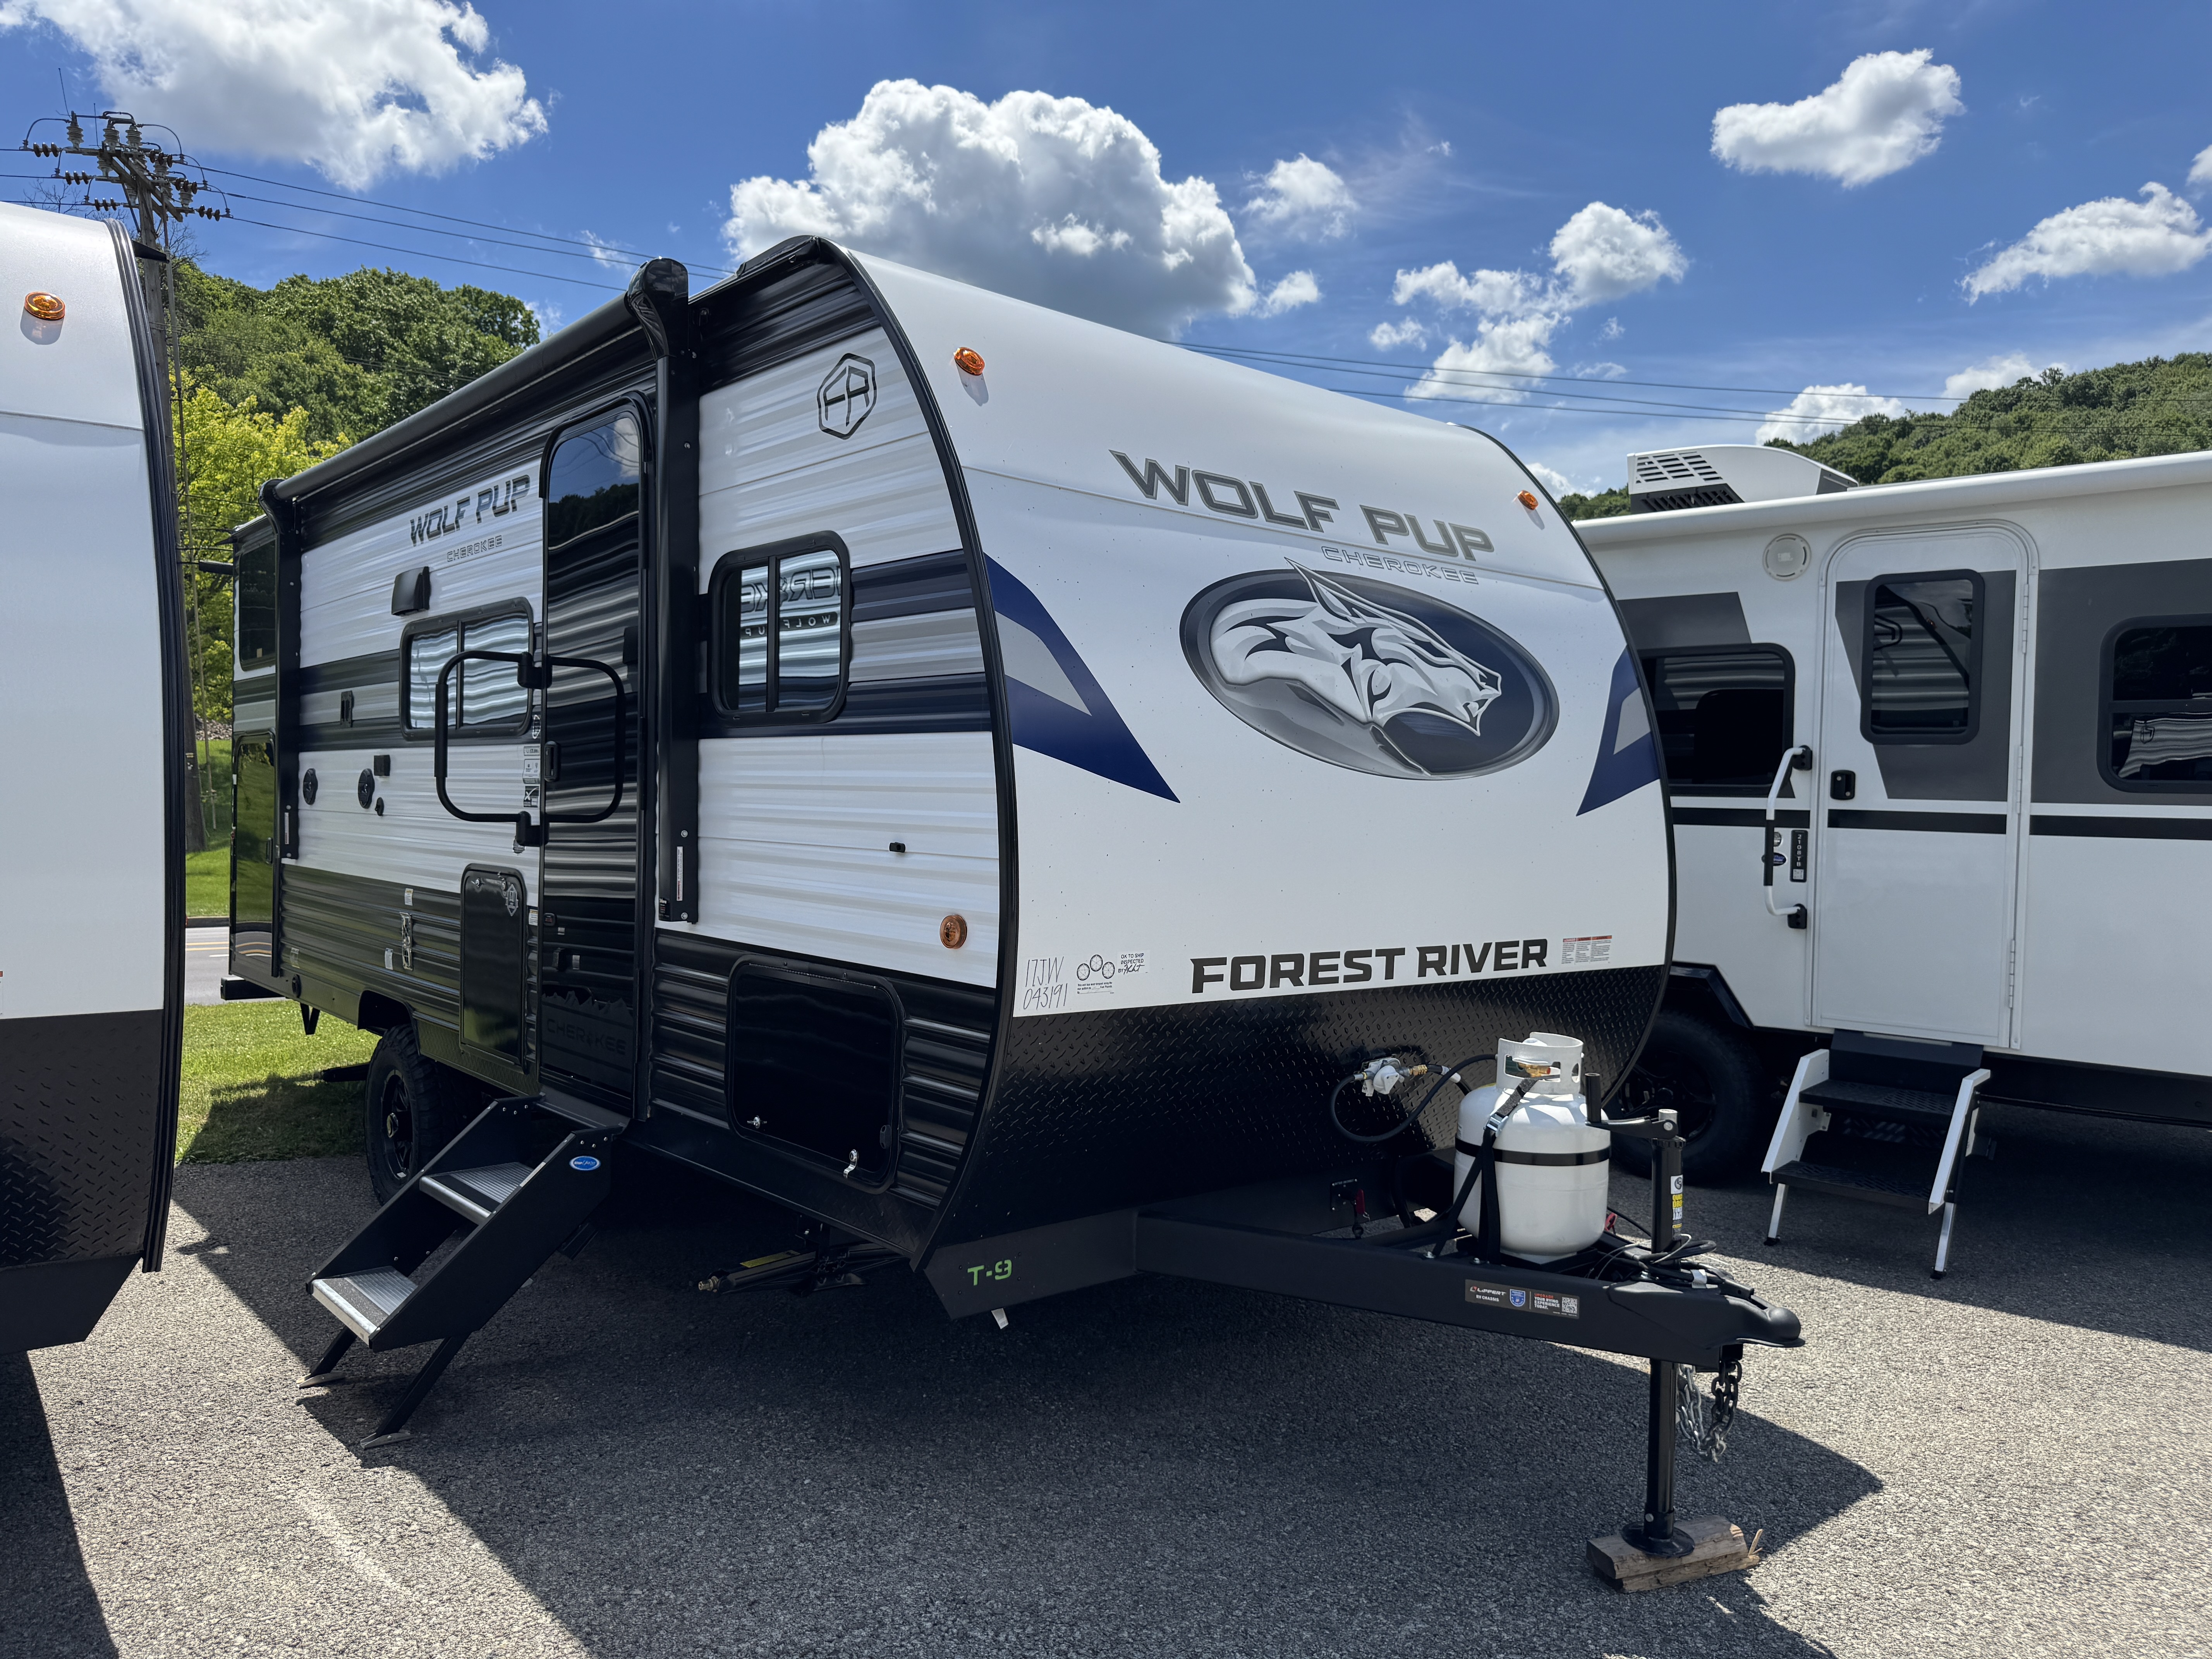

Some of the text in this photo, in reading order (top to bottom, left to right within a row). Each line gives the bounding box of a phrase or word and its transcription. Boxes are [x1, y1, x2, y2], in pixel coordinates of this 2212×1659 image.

[410, 474, 531, 547] WOLF PUP
[1109, 449, 1494, 561] WOLF PUP
[447, 535, 502, 562] CHEROKEE
[1321, 546, 1479, 585] CHEROKEE
[1190, 947, 1406, 994] FOREST
[1416, 938, 1547, 978] RIVER
[1673, 1212, 1682, 1220] JAC
[967, 1259, 1012, 1286] T-9
[1477, 1288, 1506, 1296] LIPPERT
